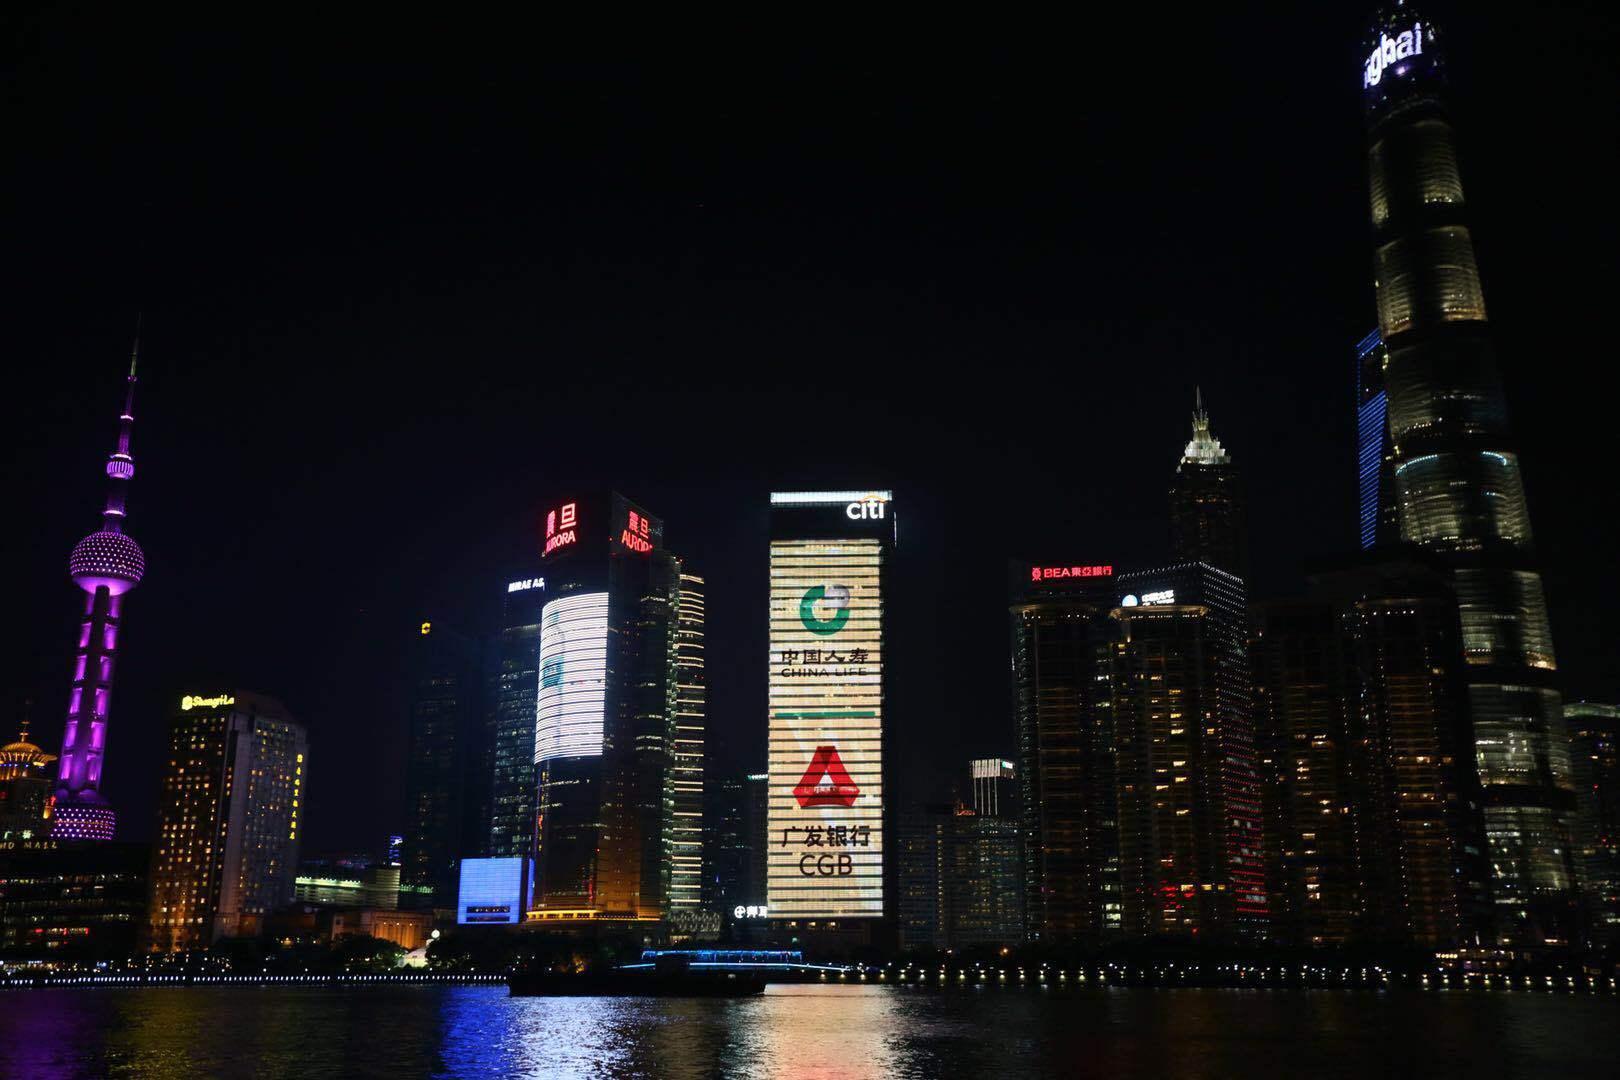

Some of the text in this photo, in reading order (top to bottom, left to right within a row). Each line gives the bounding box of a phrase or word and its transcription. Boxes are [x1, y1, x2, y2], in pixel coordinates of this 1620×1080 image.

[846, 499, 885, 520] citi
[1043, 567, 1071, 578] BEA
[781, 648, 869, 665] 中国人寿
[781, 667, 868, 678] CHINA LIFE
[781, 824, 871, 848] 广发银行
[799, 854, 853, 876] CGB
